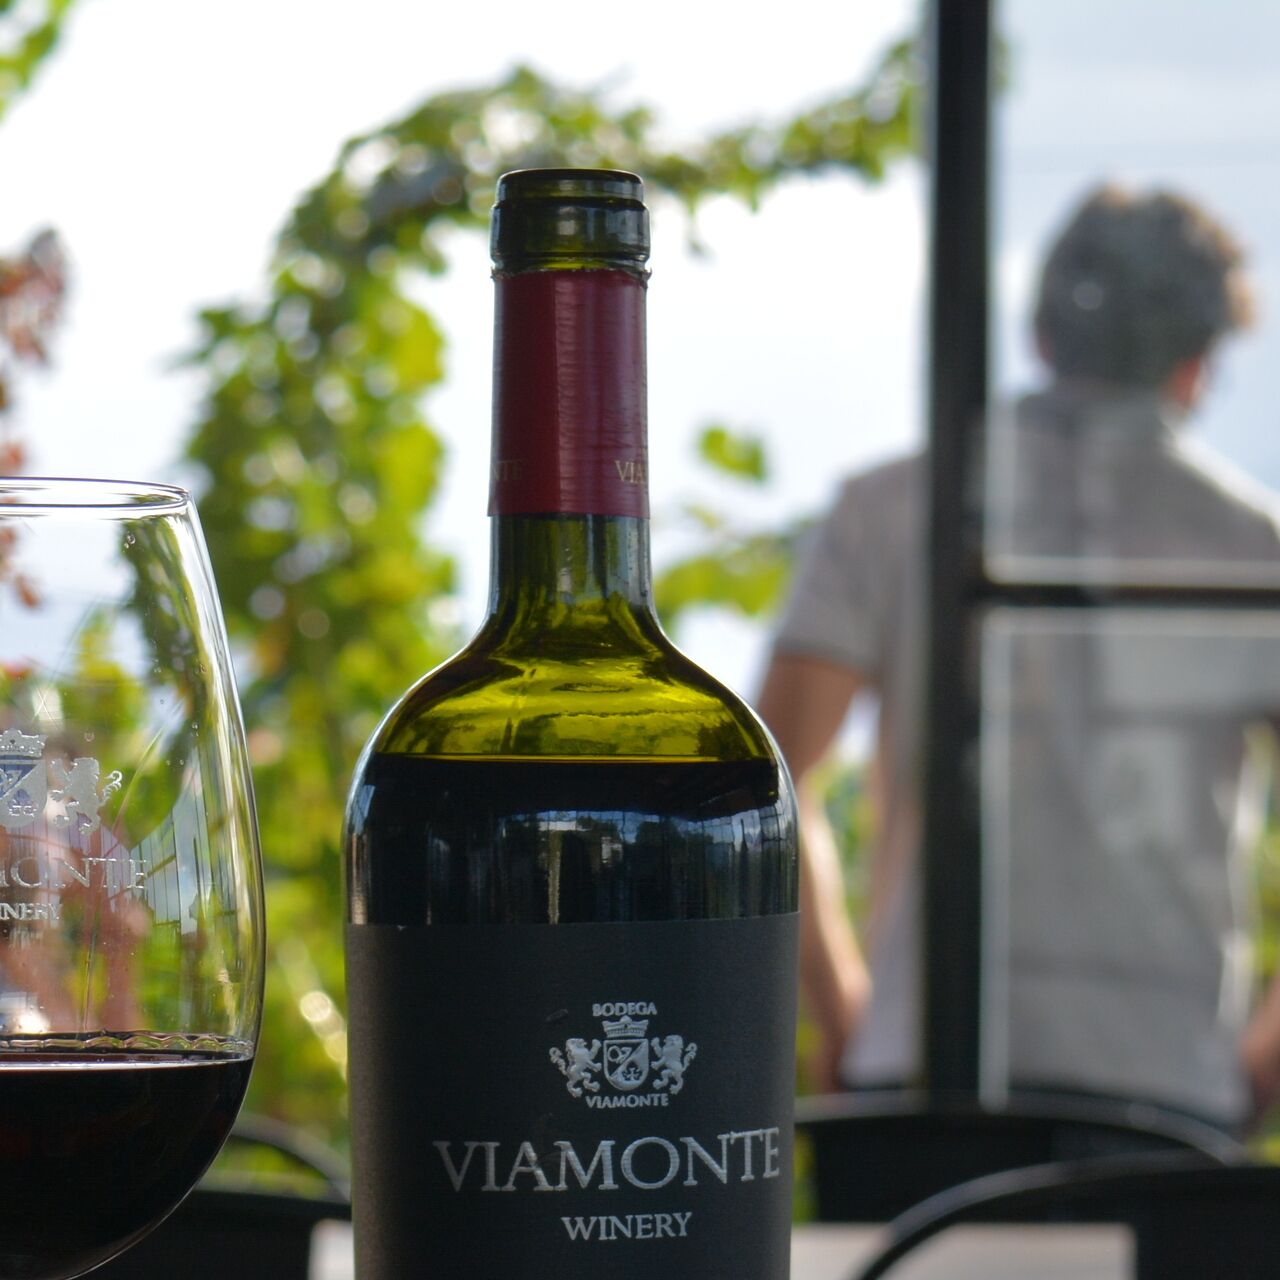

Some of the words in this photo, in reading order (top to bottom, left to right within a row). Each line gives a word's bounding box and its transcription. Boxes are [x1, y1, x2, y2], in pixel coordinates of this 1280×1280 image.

[592, 1002, 658, 1018] BODEGA
[586, 1093, 669, 1109] VIAMONTE
[433, 1127, 780, 1192] VIAMONTE
[561, 1212, 692, 1241] WINERY
